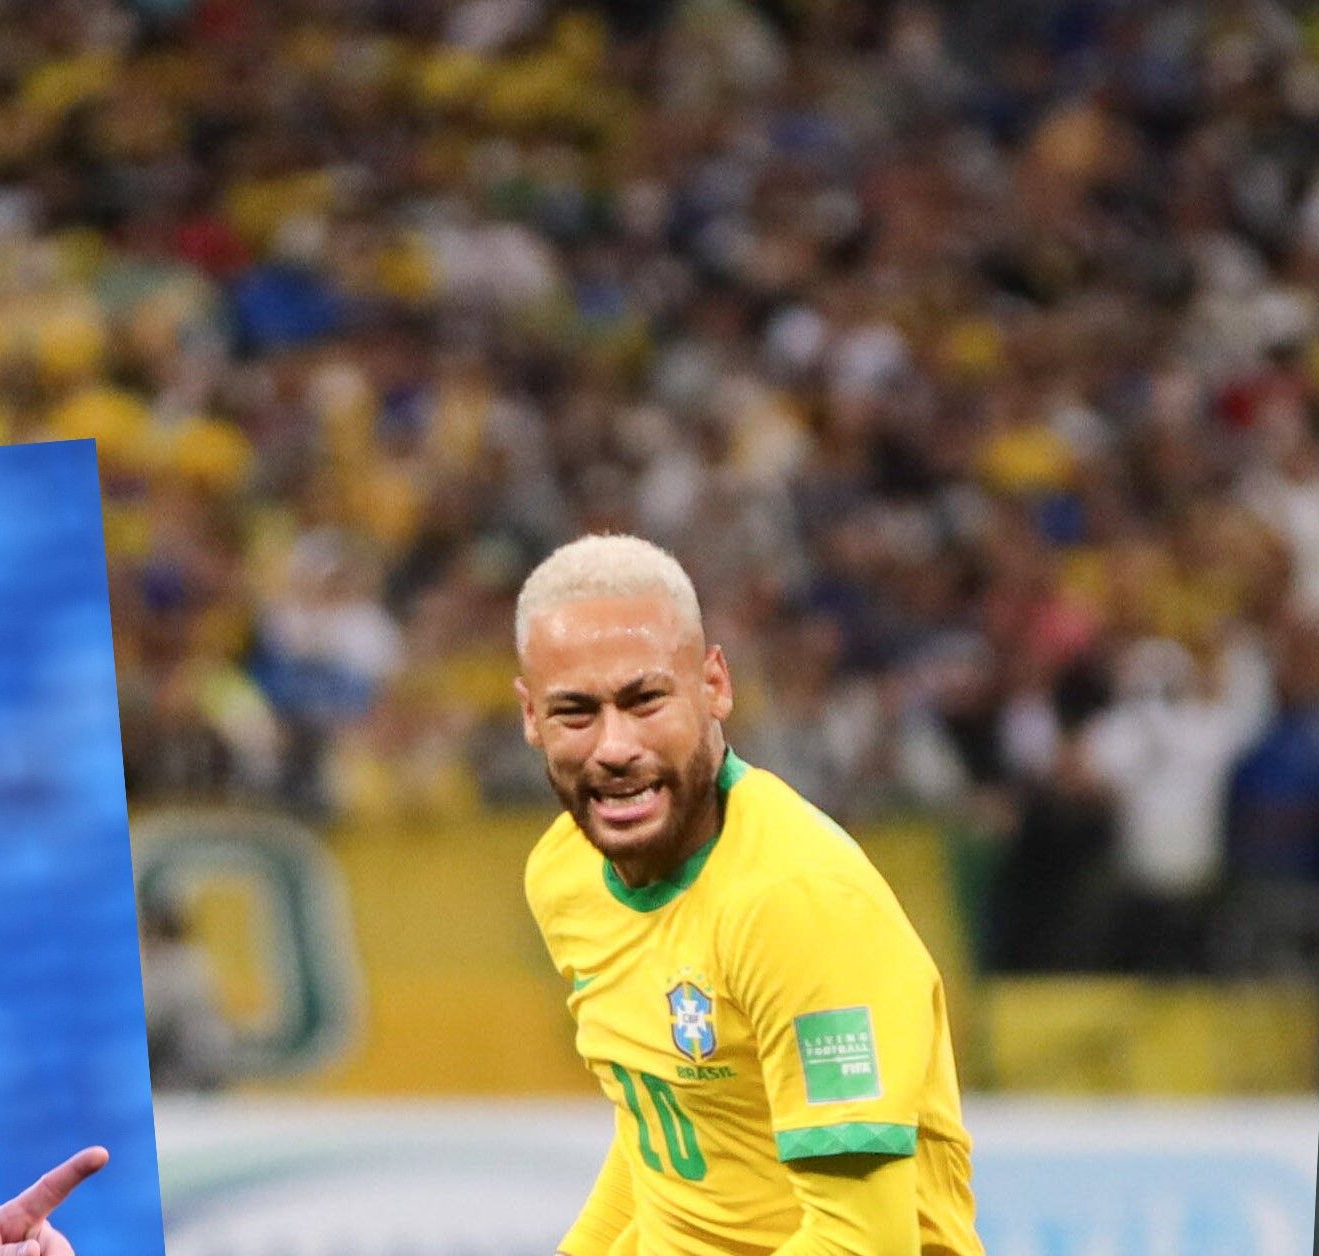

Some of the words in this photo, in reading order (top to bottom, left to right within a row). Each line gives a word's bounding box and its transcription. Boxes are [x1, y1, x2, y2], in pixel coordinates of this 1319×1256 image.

[676, 1064, 738, 1081] BRASIL
[841, 1061, 872, 1076] FIFA
[609, 1060, 709, 1182] 10
